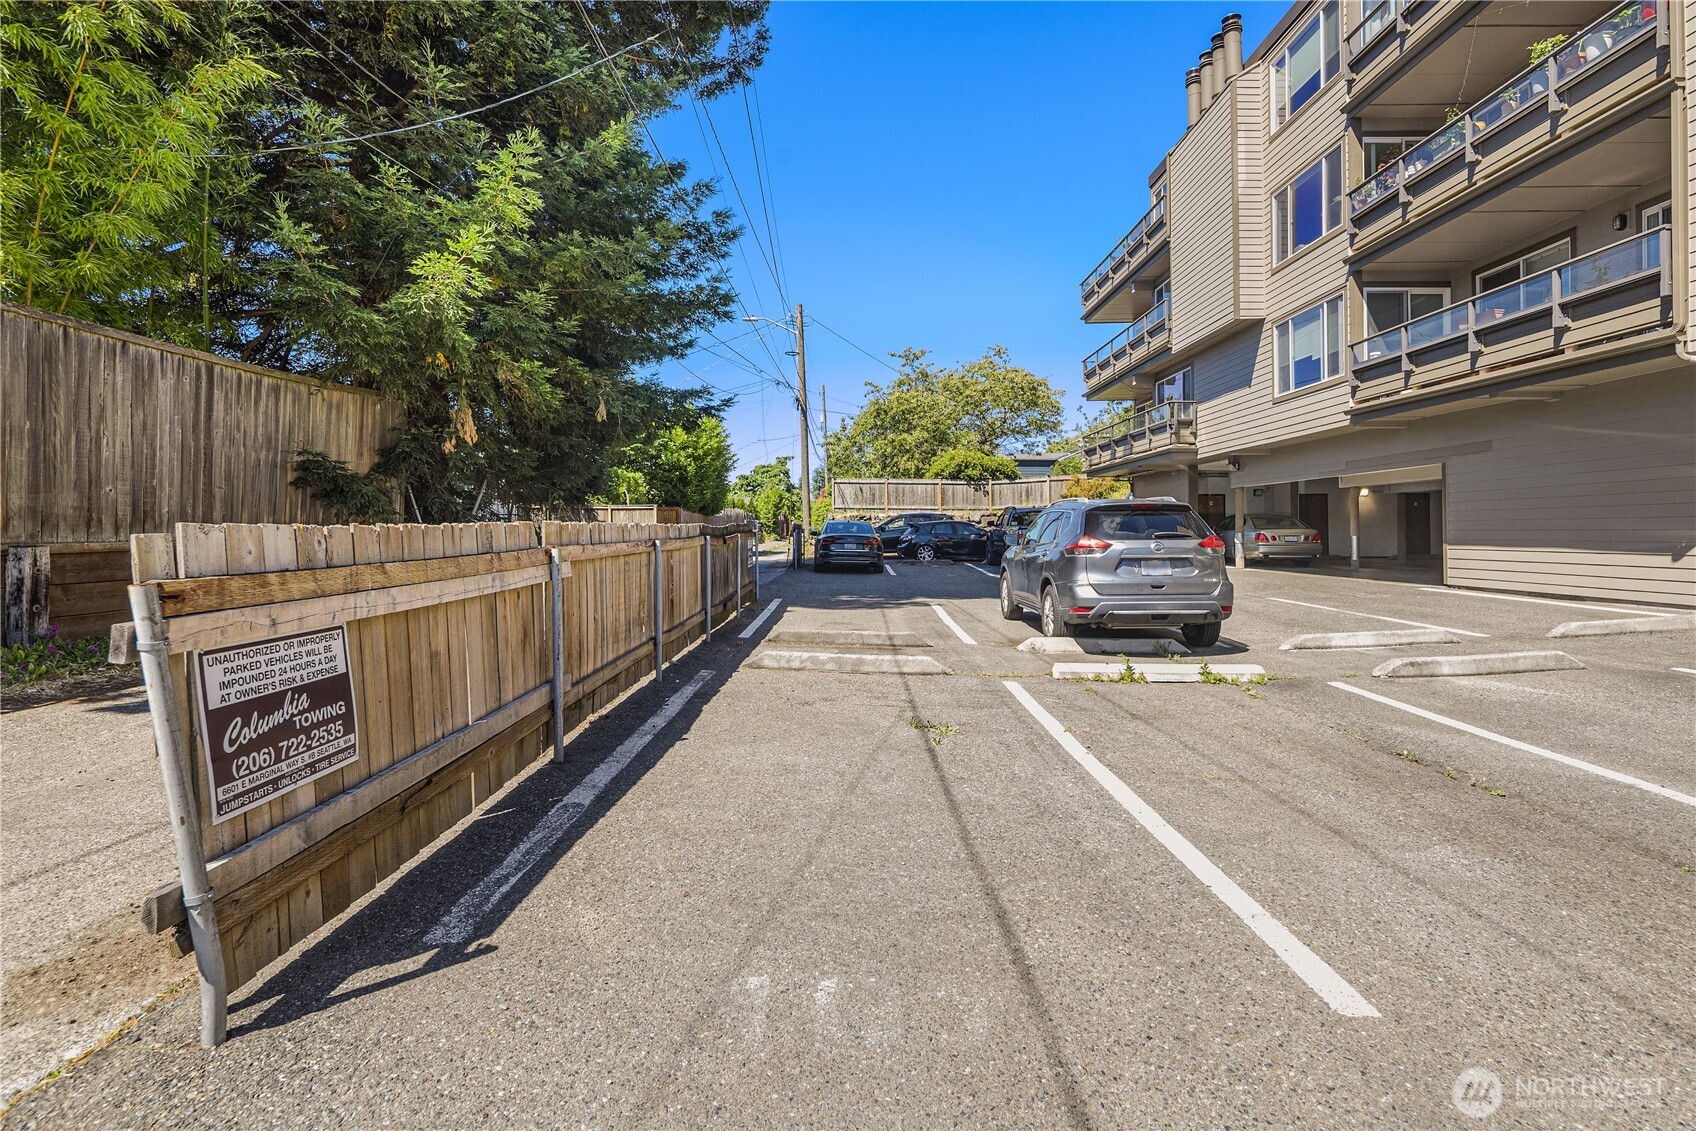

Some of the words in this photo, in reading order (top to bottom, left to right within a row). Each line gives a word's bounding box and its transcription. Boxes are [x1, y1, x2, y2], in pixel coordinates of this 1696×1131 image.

[207, 644, 280, 667] UNAUTHORIZED
[283, 642, 295, 652] OR
[297, 631, 341, 649] IMPROPERLY
[223, 660, 262, 677] PARKED
[264, 650, 303, 667] VEHICLES
[304, 647, 322, 657] WILL
[324, 644, 333, 653] BE
[219, 669, 276, 691] IMPOUNDED
[278, 667, 287, 677] 24
[290, 660, 316, 674] HOURS
[317, 658, 323, 666] A
[324, 654, 337, 664] DAY
[220, 692, 232, 704] AT
[234, 682, 277, 700] OWNER'S
[279, 676, 298, 689] RISK
[299, 674, 305, 682] &
[307, 665, 339, 680] EXPENSE
[223, 690, 310, 753] Columbia
[293, 701, 346, 729] TOWING
[222, 784, 239, 796] 6601
[241, 779, 247, 789] E
[248, 763, 284, 785] MARGINAL
[285, 757, 299, 769] WAY
[343, 736, 352, 745] WA
[232, 746, 275, 778] (206)
[278, 720, 344, 759] 722-2535
[220, 784, 274, 814] JUMPSTARTS
[278, 767, 311, 788] UNLOCKS
[315, 759, 330, 772] TIRE
[330, 748, 355, 762] SERVICE
